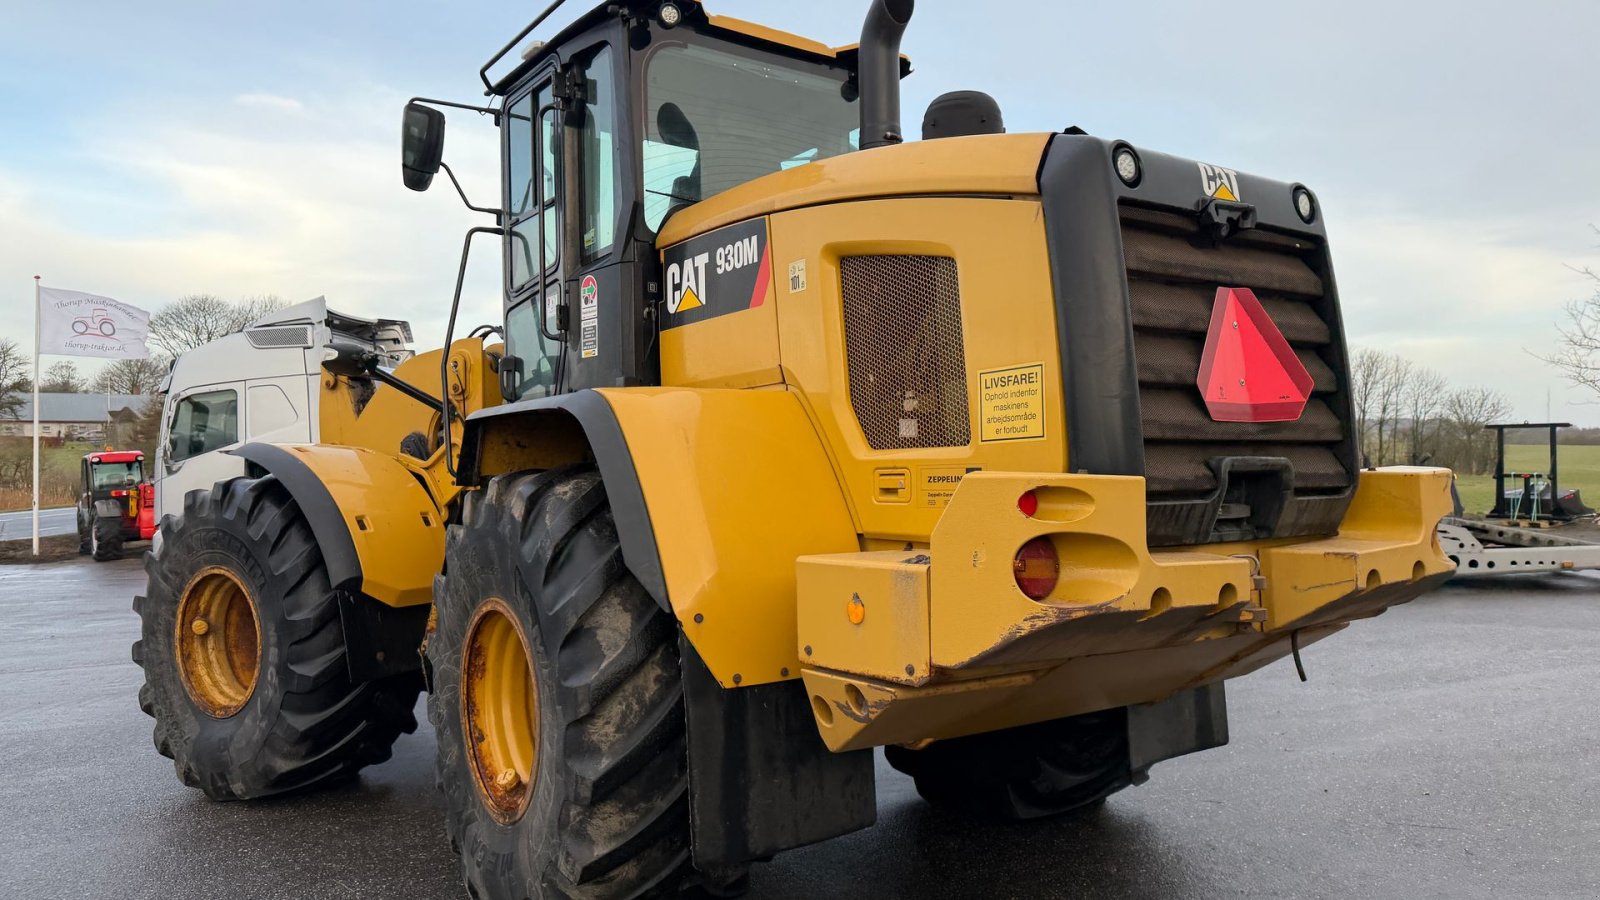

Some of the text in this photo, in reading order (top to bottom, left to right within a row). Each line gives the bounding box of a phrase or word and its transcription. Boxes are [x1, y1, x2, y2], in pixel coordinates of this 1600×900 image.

[1197, 162, 1240, 202] CAT
[715, 234, 758, 275] 930M
[666, 252, 709, 314] CAT
[55, 299, 82, 309] Thorup
[984, 372, 1038, 389] LIVSFARE!
[984, 387, 1038, 402] Ophold indenfor
[993, 401, 1029, 412] maskinens
[986, 412, 1037, 424] arbejdsområde
[1003, 425, 1028, 434] forbudt
[927, 475, 963, 483] ZEPPELIN
